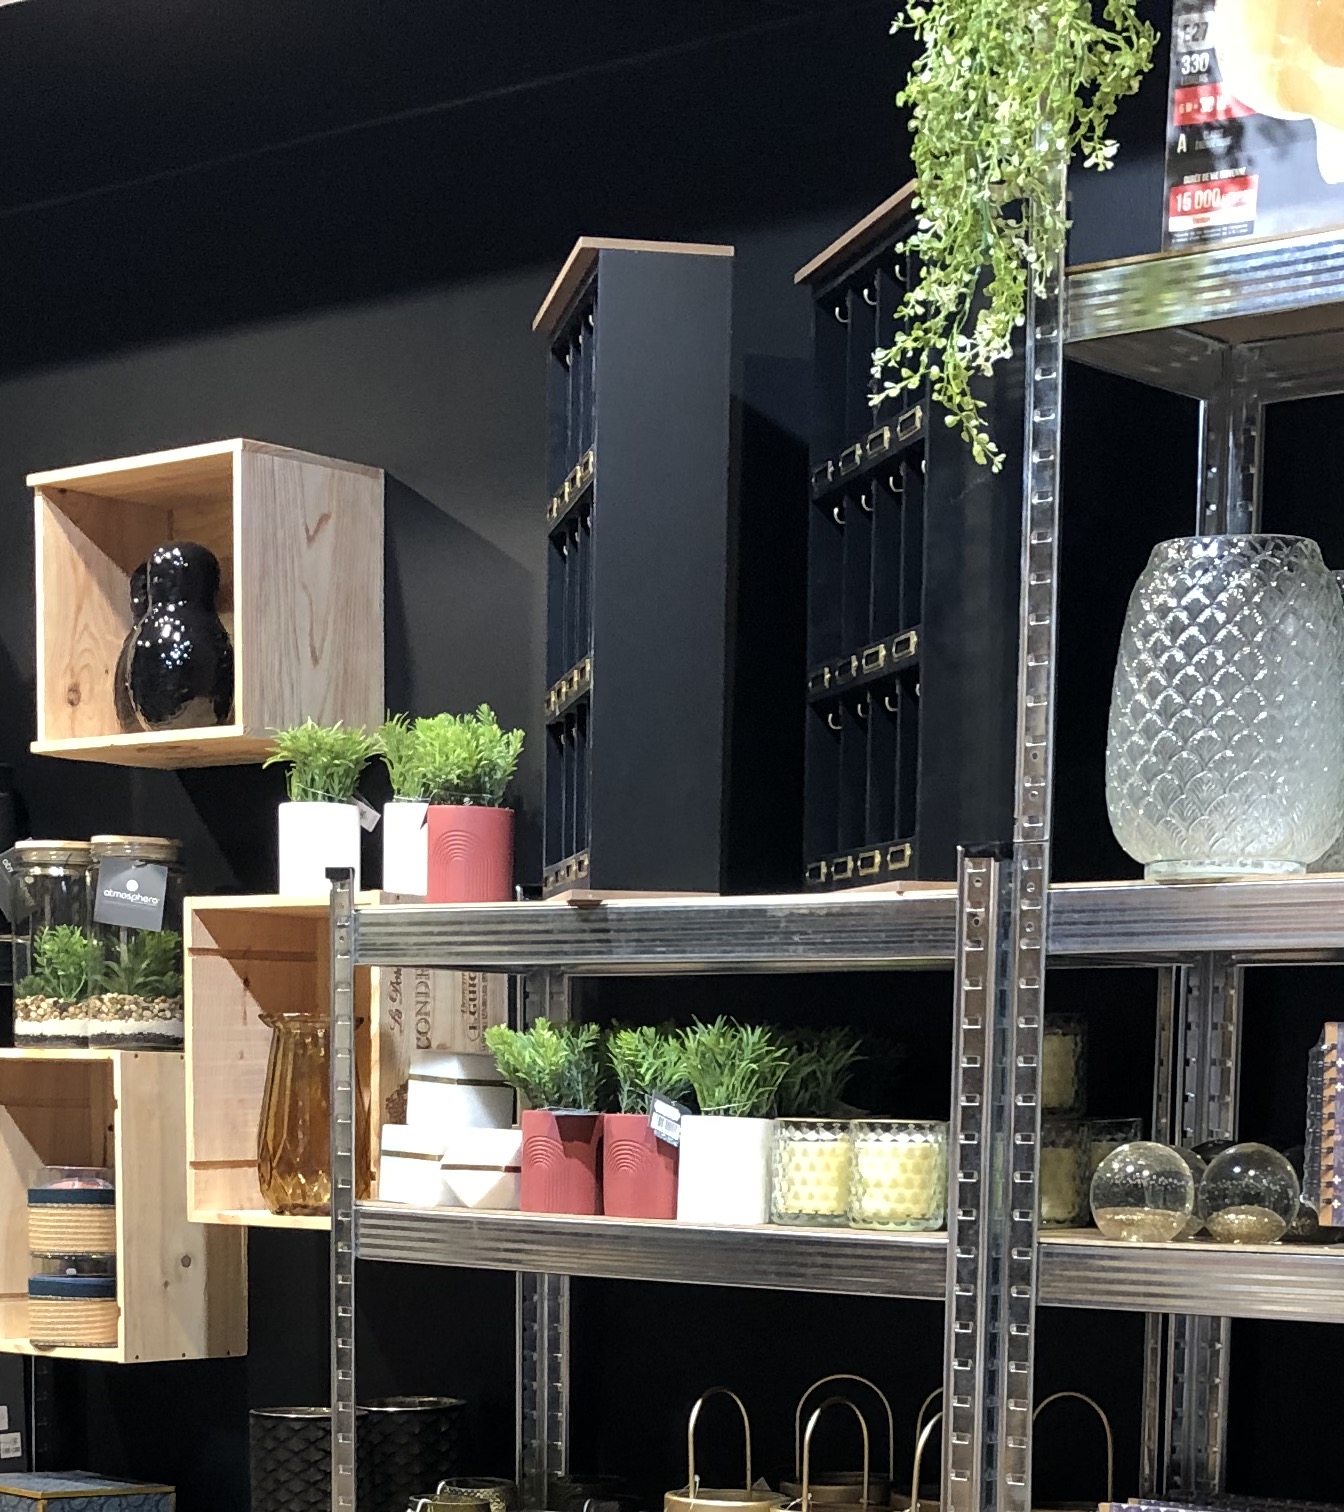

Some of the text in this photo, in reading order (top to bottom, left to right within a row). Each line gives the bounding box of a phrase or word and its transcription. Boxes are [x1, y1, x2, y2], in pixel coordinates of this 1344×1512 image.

[1180, 52, 1210, 74] 330
[1176, 134, 1188, 154] A
[103, 888, 160, 906] atmosphera
